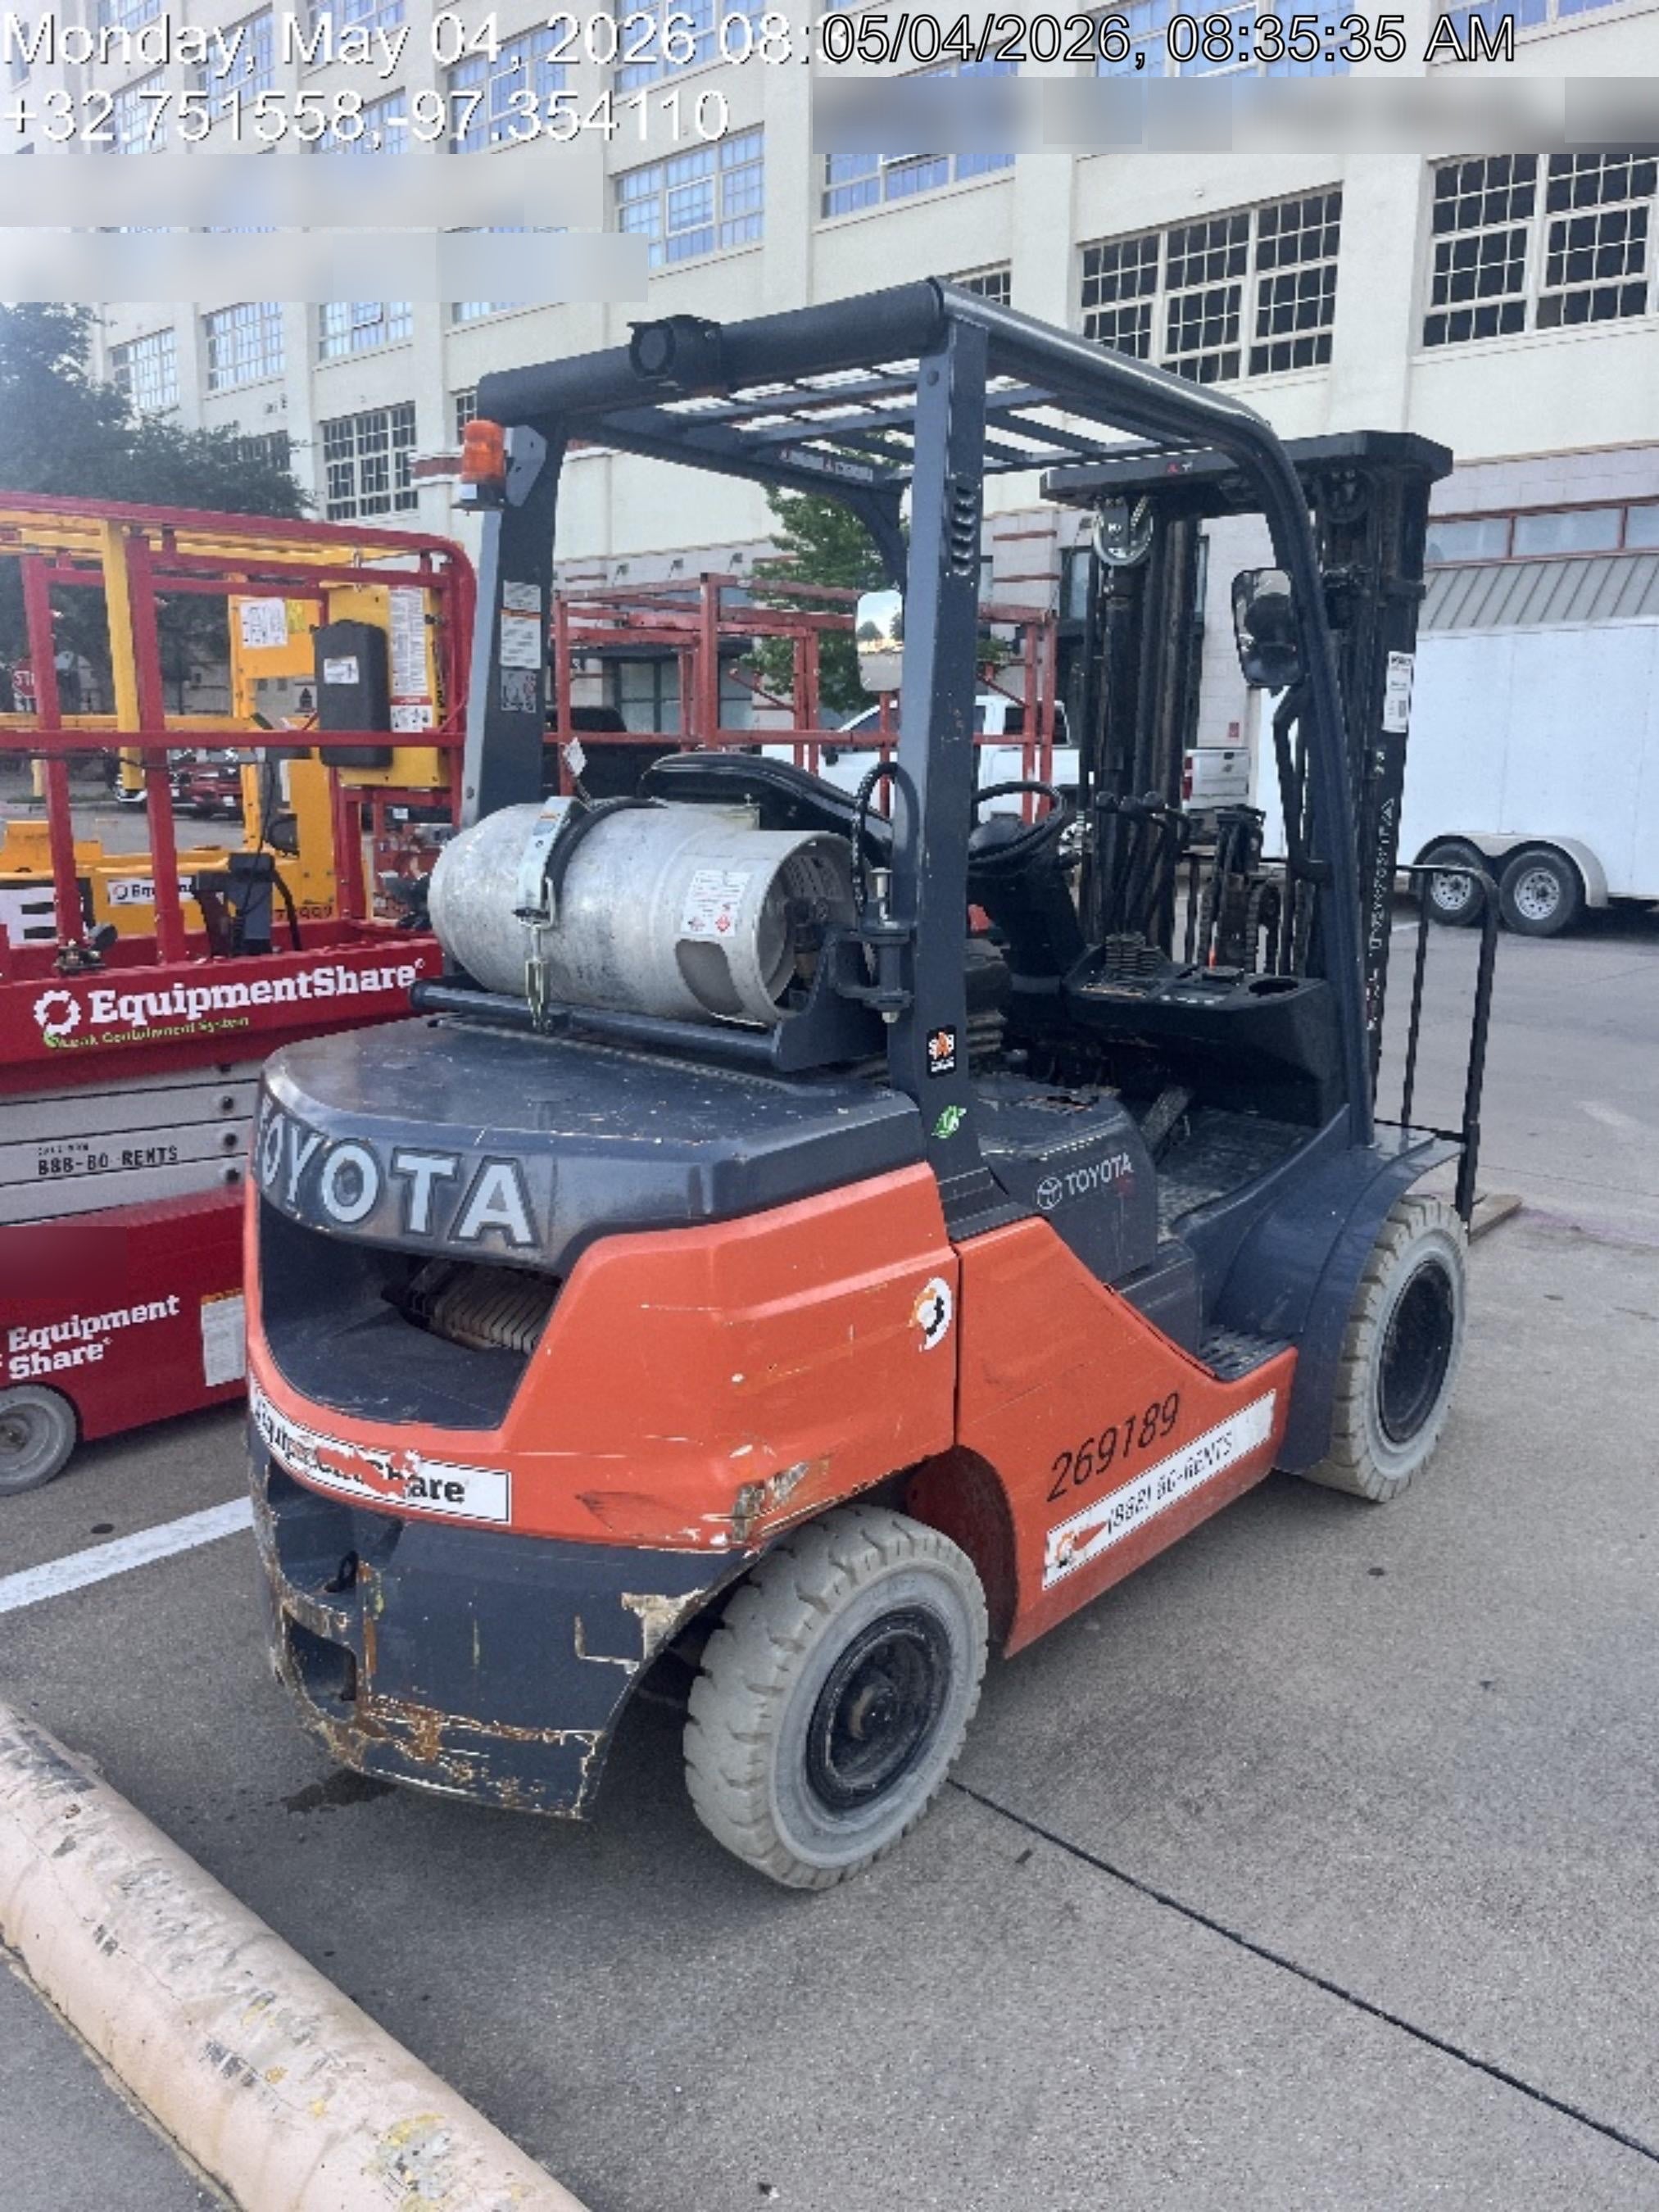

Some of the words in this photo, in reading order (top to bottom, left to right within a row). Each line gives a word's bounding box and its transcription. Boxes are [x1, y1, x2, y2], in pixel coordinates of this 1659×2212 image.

[88, 964, 416, 1027] EquipmentShare
[1064, 1152, 1134, 1195] TOYOTA
[7, 1294, 180, 1352] Equipment
[9, 1344, 105, 1380] Share
[1047, 1392, 1180, 1503] 269189
